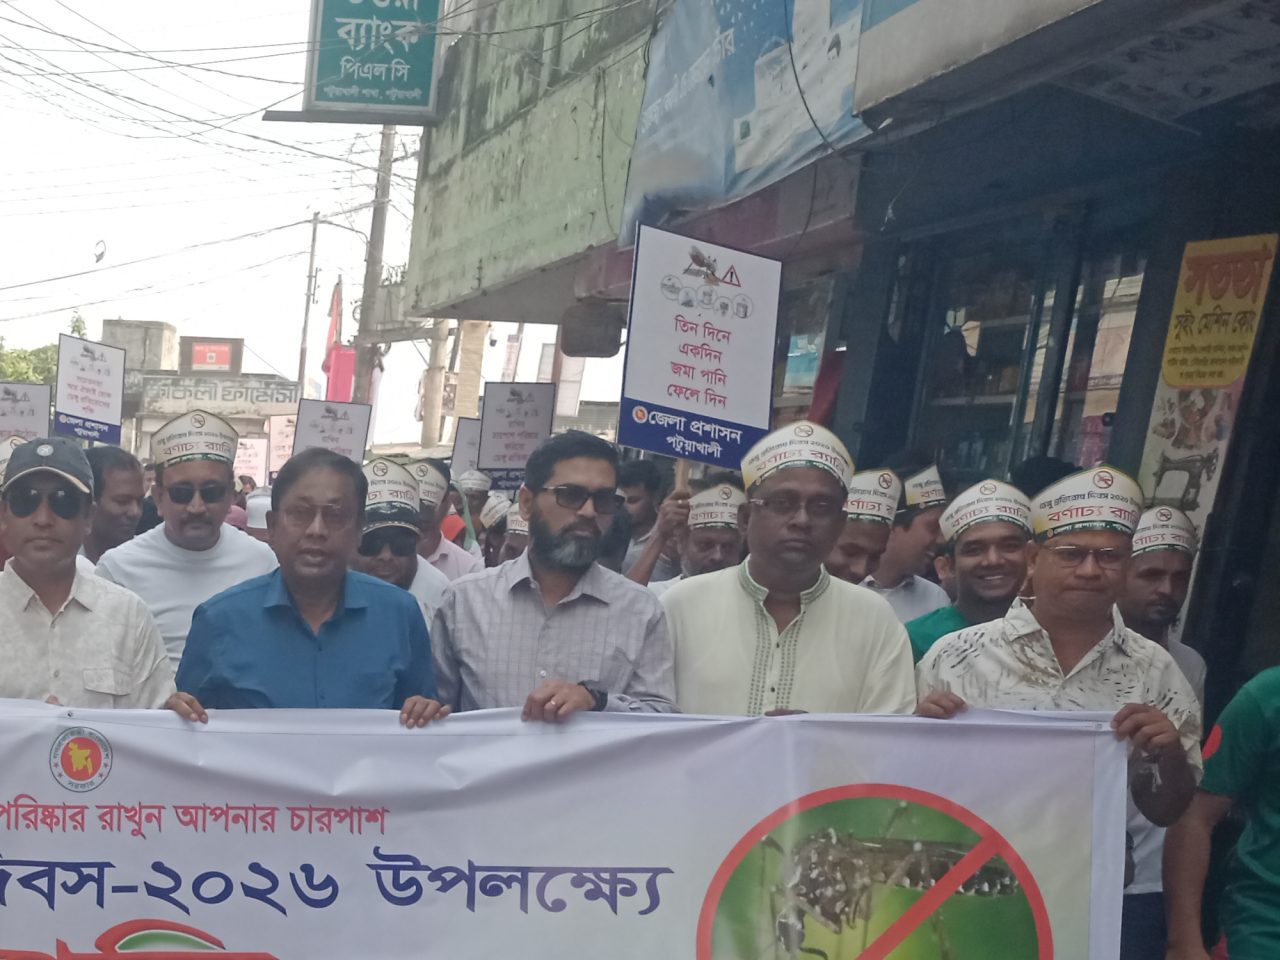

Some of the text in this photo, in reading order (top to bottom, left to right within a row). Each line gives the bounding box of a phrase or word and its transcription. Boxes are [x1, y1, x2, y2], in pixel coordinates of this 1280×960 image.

[334, 15, 422, 55] ব্যাংক
[1183, 243, 1273, 306] সততা
[675, 314, 731, 344] তিন দিনে
[679, 342, 722, 364] একদিন
[671, 361, 727, 386] জমা পানি
[667, 383, 727, 408] ফেলে দিন
[649, 411, 742, 444] জেলা প্রশাসন
[666, 434, 722, 458] পটুয়াখালী
[1047, 505, 1104, 521] বর্ণাঢ্য
[97, 803, 163, 838] রাখুন
[174, 804, 279, 833] আপনার
[288, 805, 390, 835] চারপাশ
[367, 846, 674, 915] উপলক্ষ্যে
